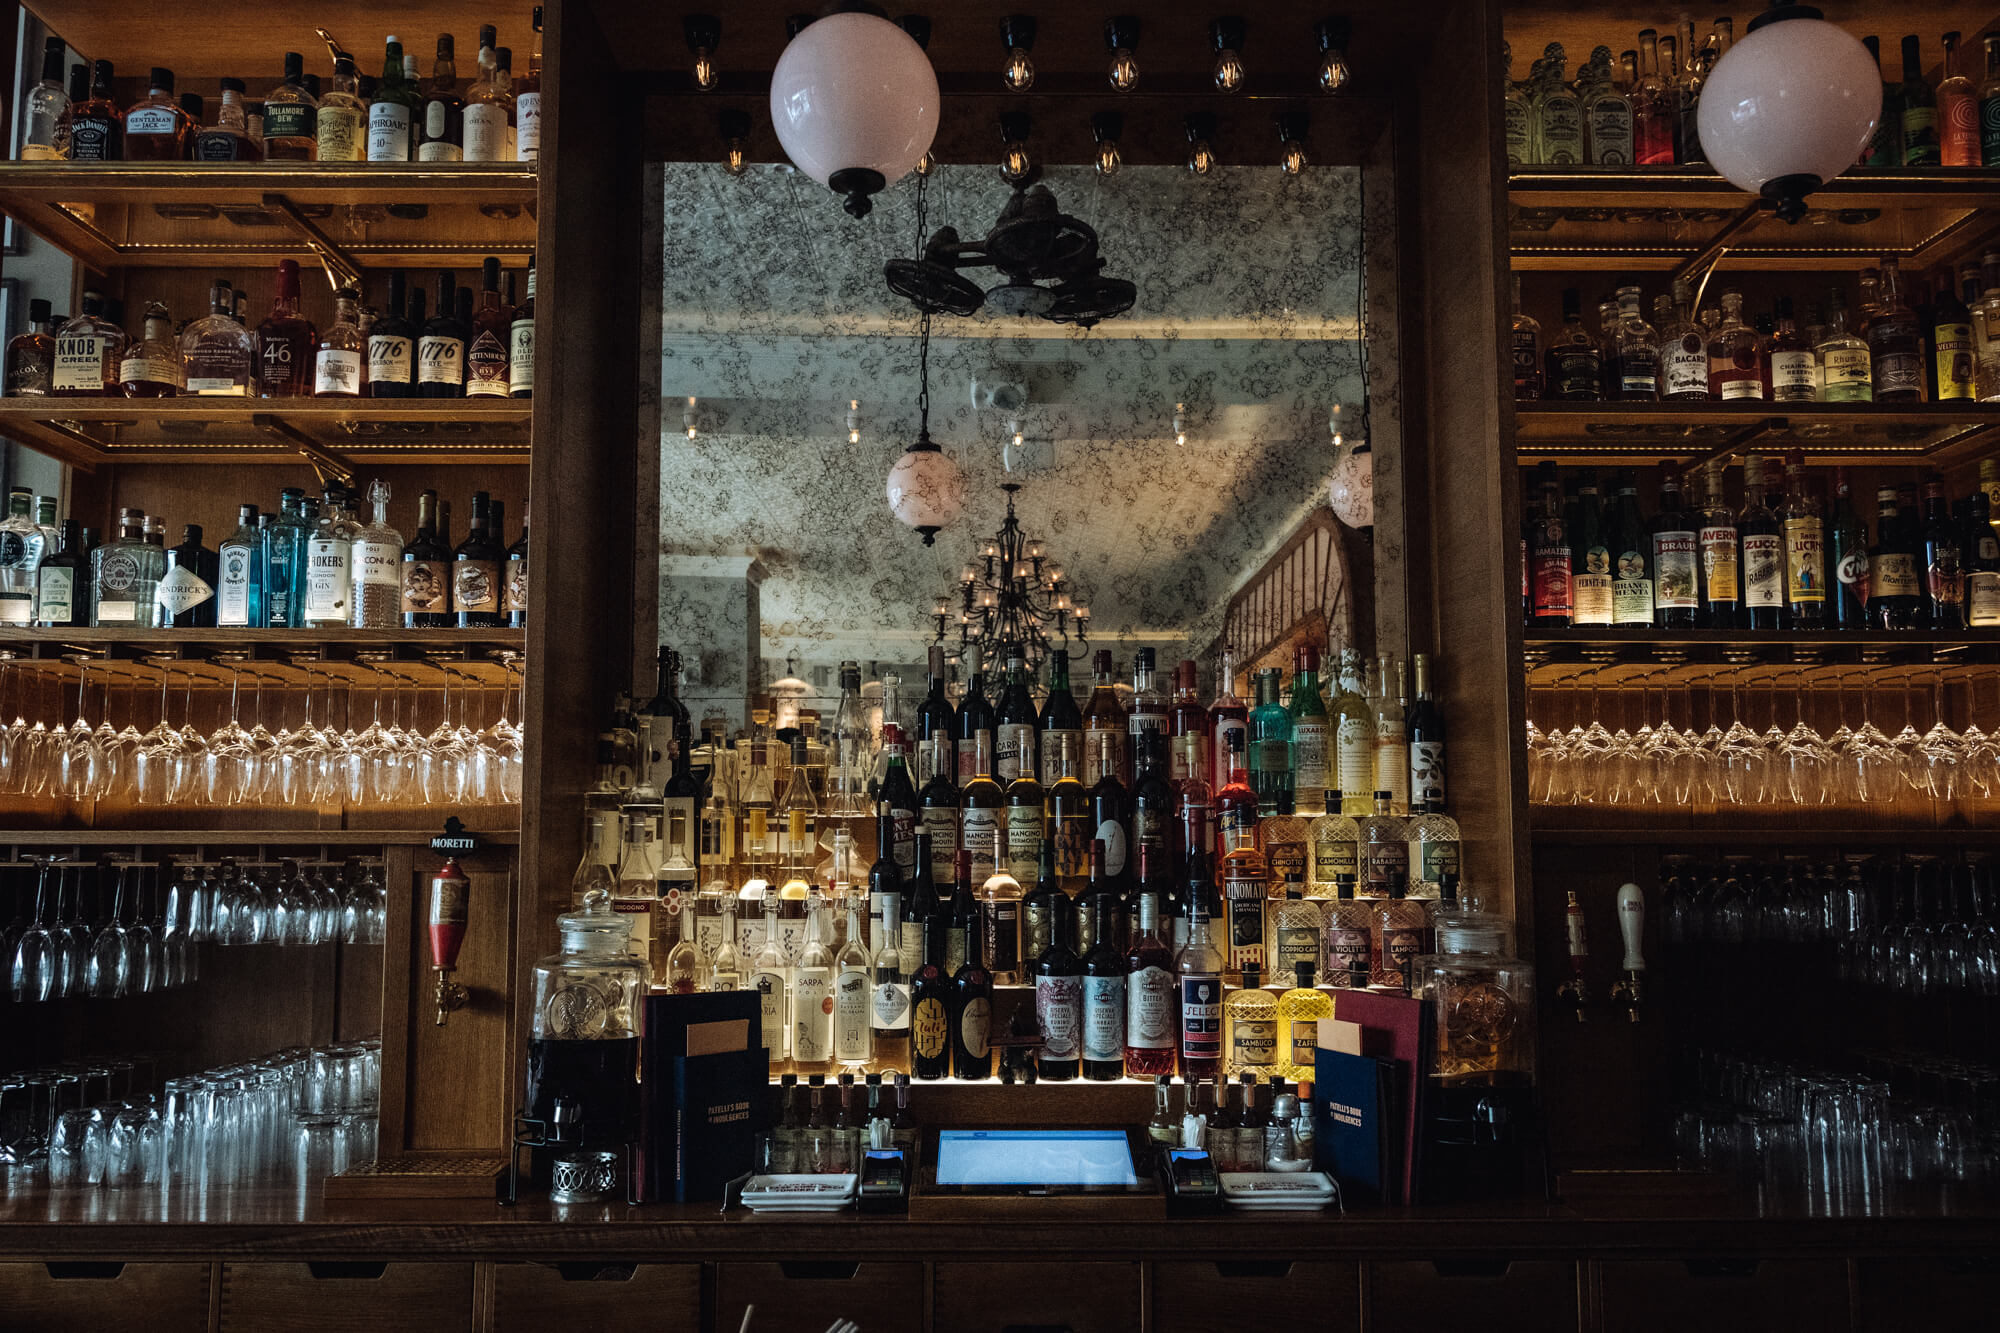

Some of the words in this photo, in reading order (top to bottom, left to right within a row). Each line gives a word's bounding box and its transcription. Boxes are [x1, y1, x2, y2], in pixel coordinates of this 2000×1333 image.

[267, 105, 305, 116] TULLAMORE
[369, 119, 407, 131] APHROAIG
[376, 138, 385, 148] 10
[58, 338, 95, 355] KNOB
[369, 340, 406, 360] 1776
[419, 341, 458, 362] 1776
[263, 343, 292, 365] 46
[1675, 355, 1706, 364] BACARD
[1745, 540, 1778, 550] ZUCC
[227, 550, 246, 558] BOMBAY
[386, 558, 395, 566] 46
[160, 585, 208, 595] ENDRICK'S
[1614, 582, 1649, 590] BRANCA
[1297, 727, 1328, 735] LUXARDO
[1010, 830, 1041, 838] MANCINO
[431, 837, 475, 849] MORETTI
[1271, 858, 1304, 866] CHINOTTO
[1319, 857, 1355, 865] CAMOMILLA
[1426, 857, 1444, 866] PINO
[1226, 882, 1268, 900] RINOMATO
[1334, 945, 1368, 953] VIOLETTA
[798, 978, 825, 986] SARPA
[1142, 994, 1162, 1002] BITTER
[1184, 1006, 1220, 1016] SELECT
[1240, 1038, 1274, 1048] SAMBUCO
